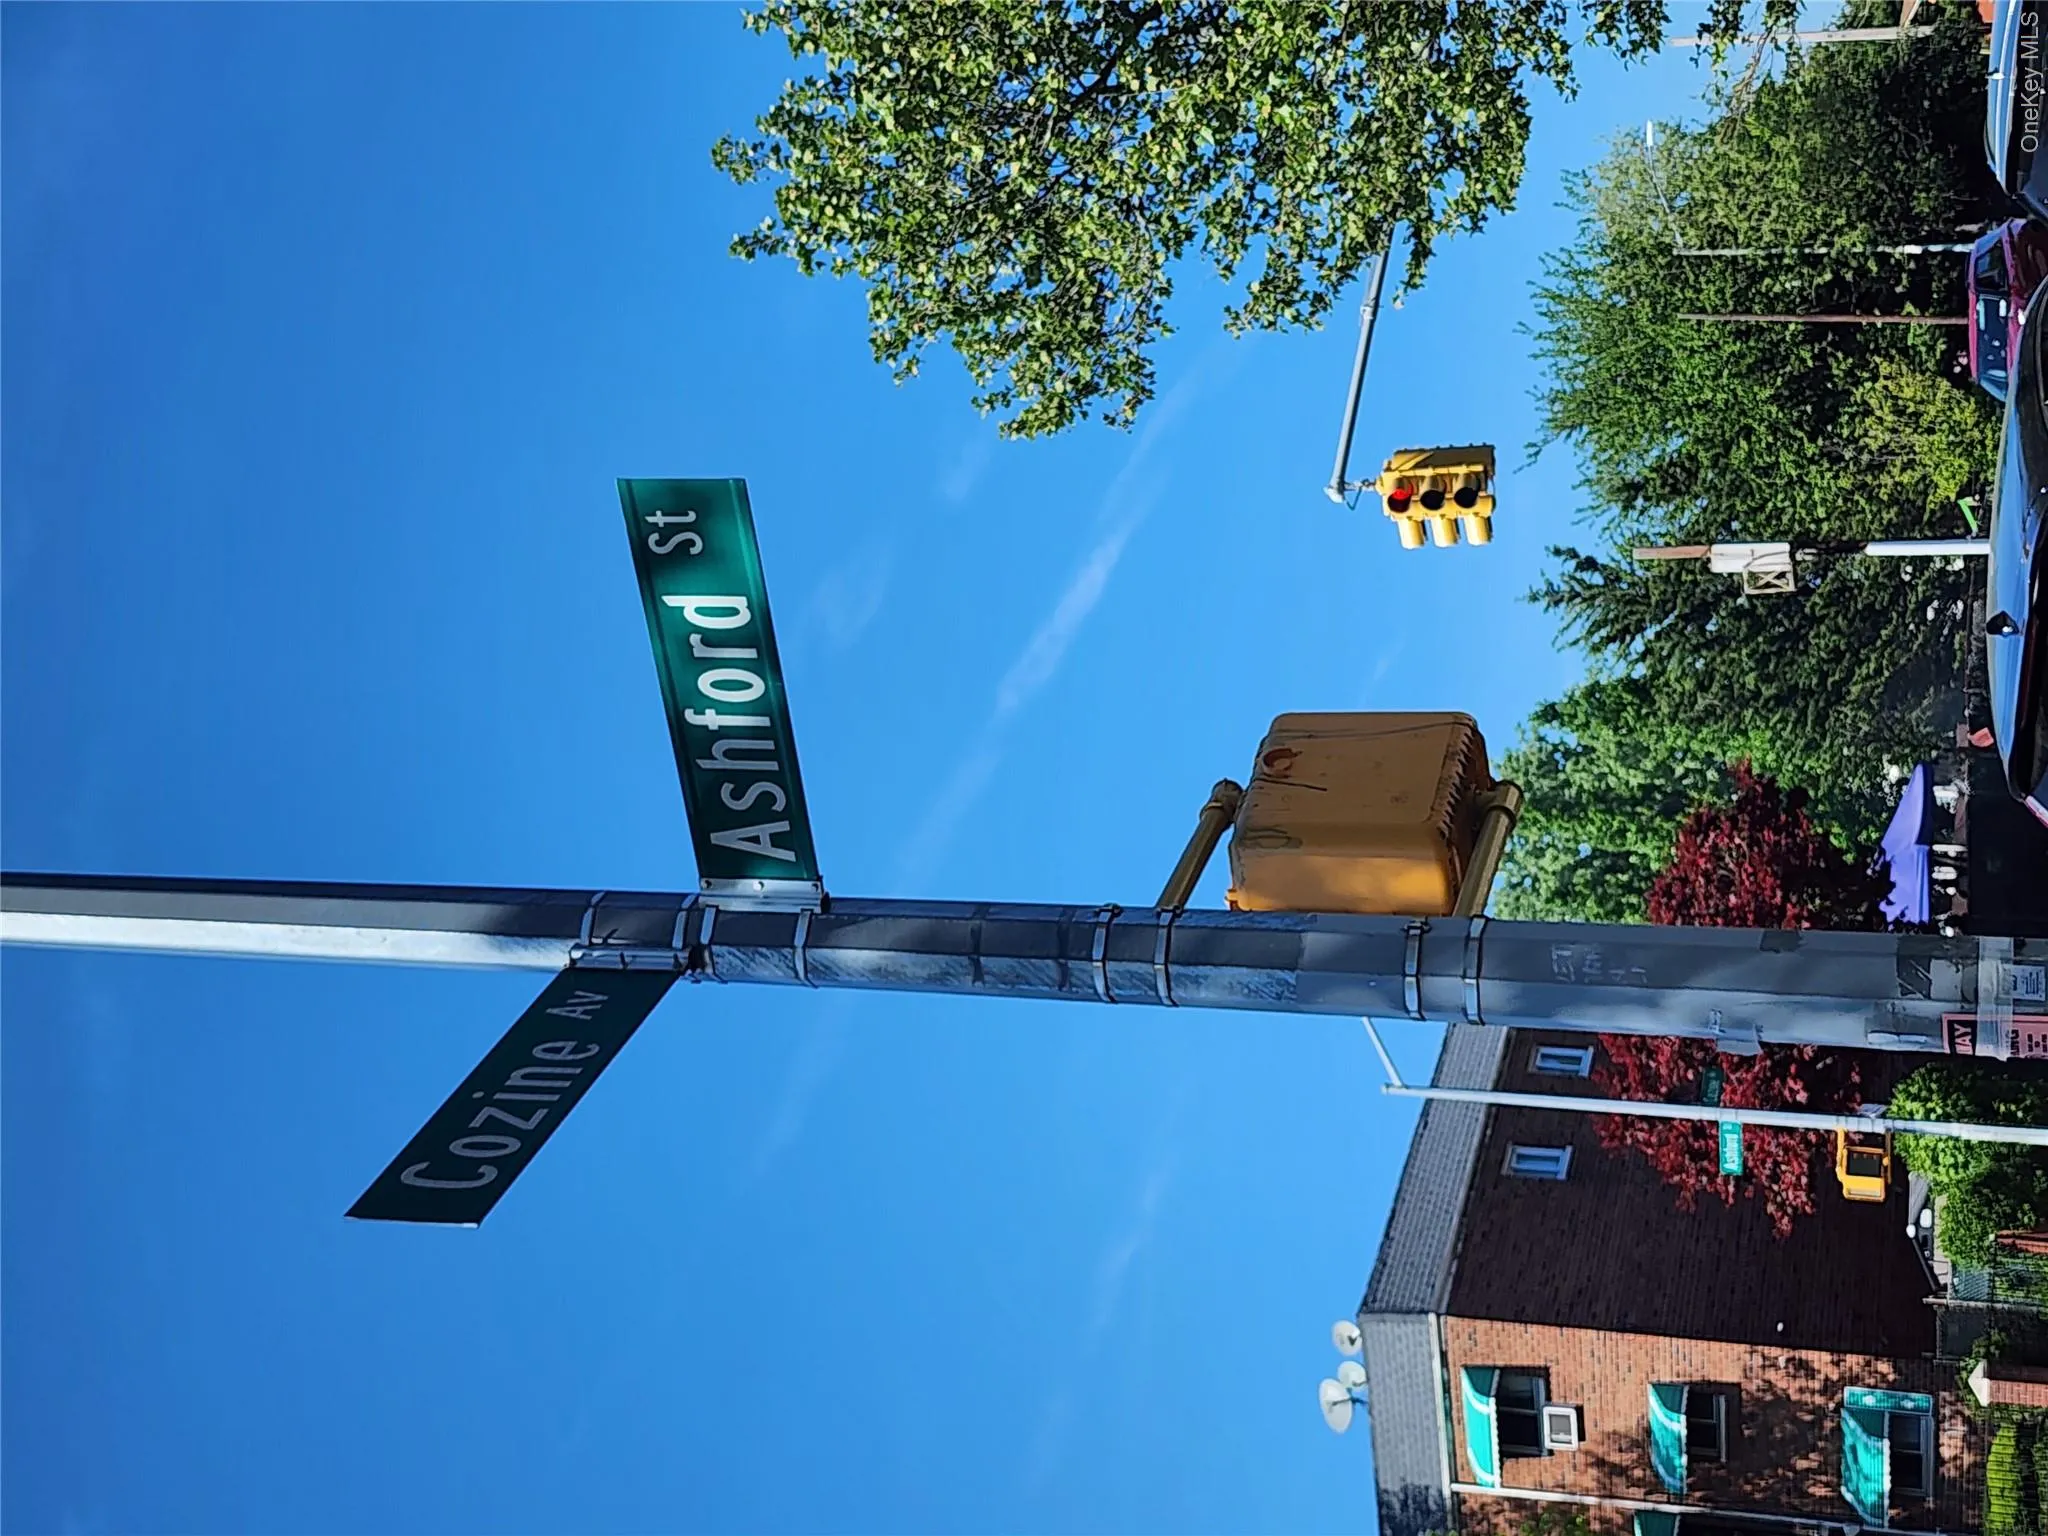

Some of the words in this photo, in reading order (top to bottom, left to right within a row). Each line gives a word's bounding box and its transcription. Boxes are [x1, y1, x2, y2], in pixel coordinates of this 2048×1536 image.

[645, 509, 704, 556] St
[661, 594, 796, 862] Ashford
[400, 1040, 600, 1189] Cozine
[1722, 1133, 1739, 1171] Ashford
